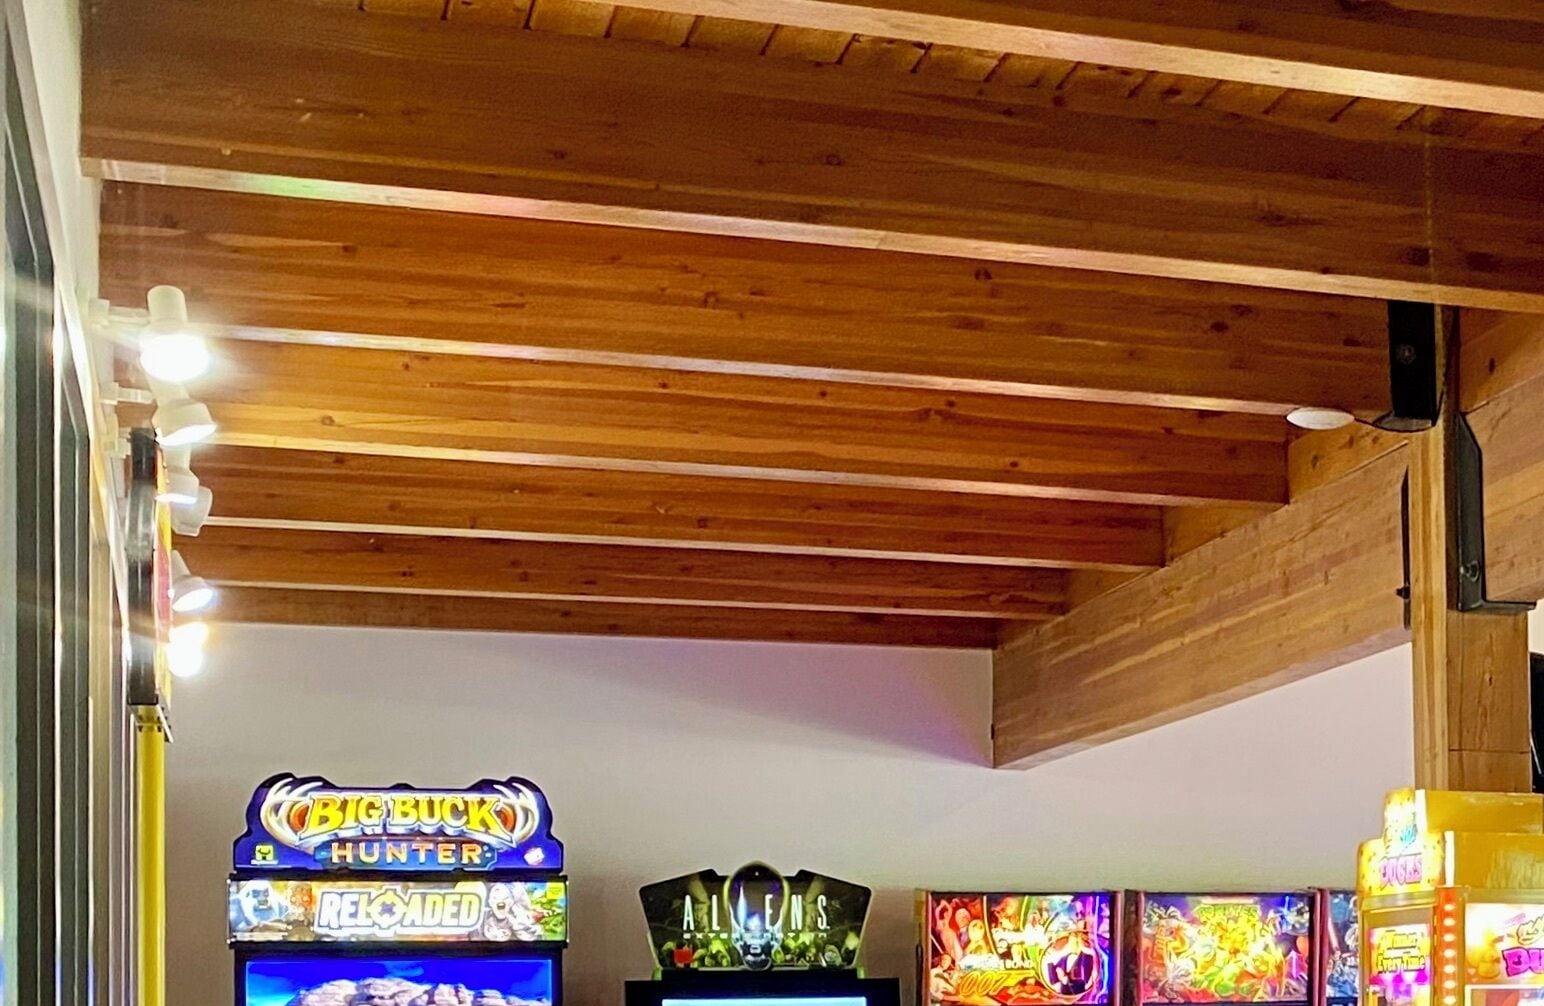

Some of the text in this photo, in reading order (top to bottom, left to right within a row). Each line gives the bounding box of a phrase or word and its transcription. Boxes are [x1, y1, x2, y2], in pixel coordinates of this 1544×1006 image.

[301, 793, 510, 840] BIG BUCK
[331, 843, 484, 865] HUNTER
[319, 888, 482, 930] RELOADED
[683, 892, 829, 931] ALIENS
[959, 970, 1022, 996] 007
